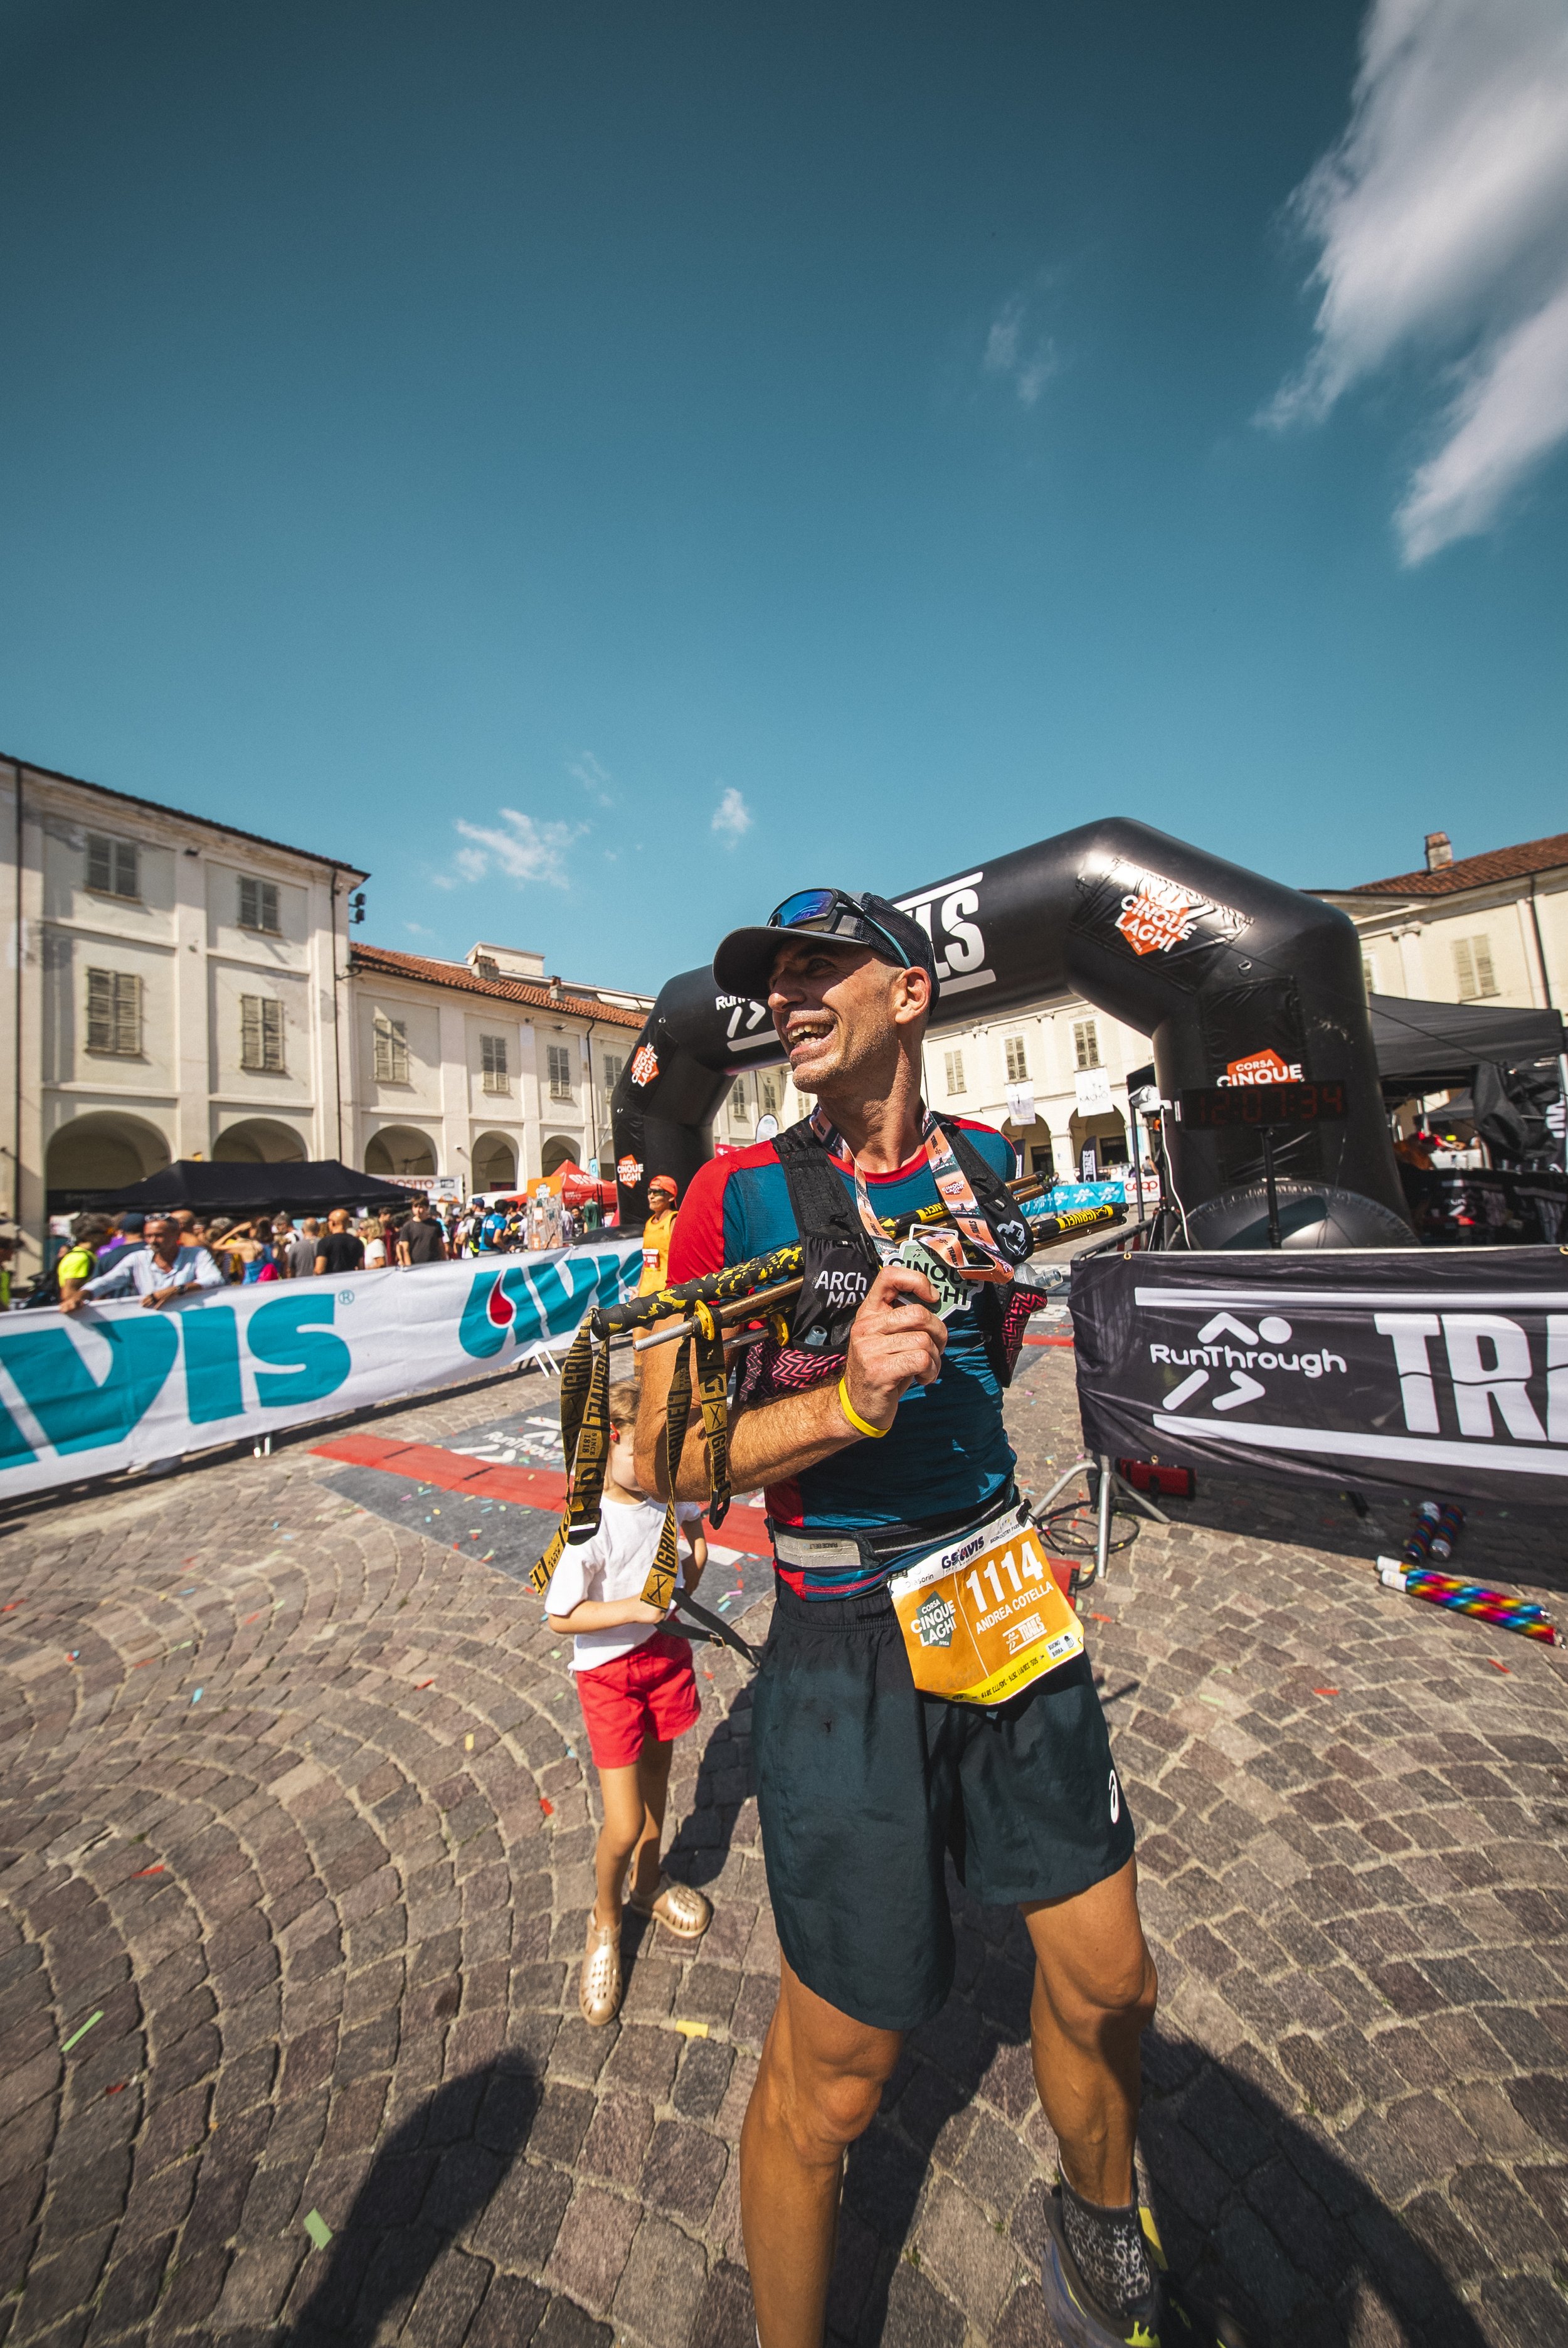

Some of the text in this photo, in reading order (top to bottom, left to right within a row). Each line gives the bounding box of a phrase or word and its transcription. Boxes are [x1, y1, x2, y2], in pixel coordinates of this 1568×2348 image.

[1115, 912, 1177, 952] LAGHI
[1121, 895, 1197, 940] CINQUE
[638, 1051, 659, 1087] LAGHI
[1216, 1063, 1303, 1088] CINQUE
[1236, 1059, 1274, 1072] CORSA
[1200, 1085, 1343, 1125] 12:07:34
[617, 1164, 644, 1174] CINQUE
[619, 1172, 641, 1182] LAGHI
[1150, 1344, 1347, 1379] RunThrough
[583, 1434, 591, 1453] 1818
[966, 1541, 1044, 1613] 1114
[911, 1600, 956, 1634] CINQUE
[921, 1599, 941, 1614] CORSA
[976, 1581, 1054, 1635] ANDREA COTELLA
[919, 1616, 957, 1647] LAGHI
[1018, 1616, 1045, 1642] TRAILS
